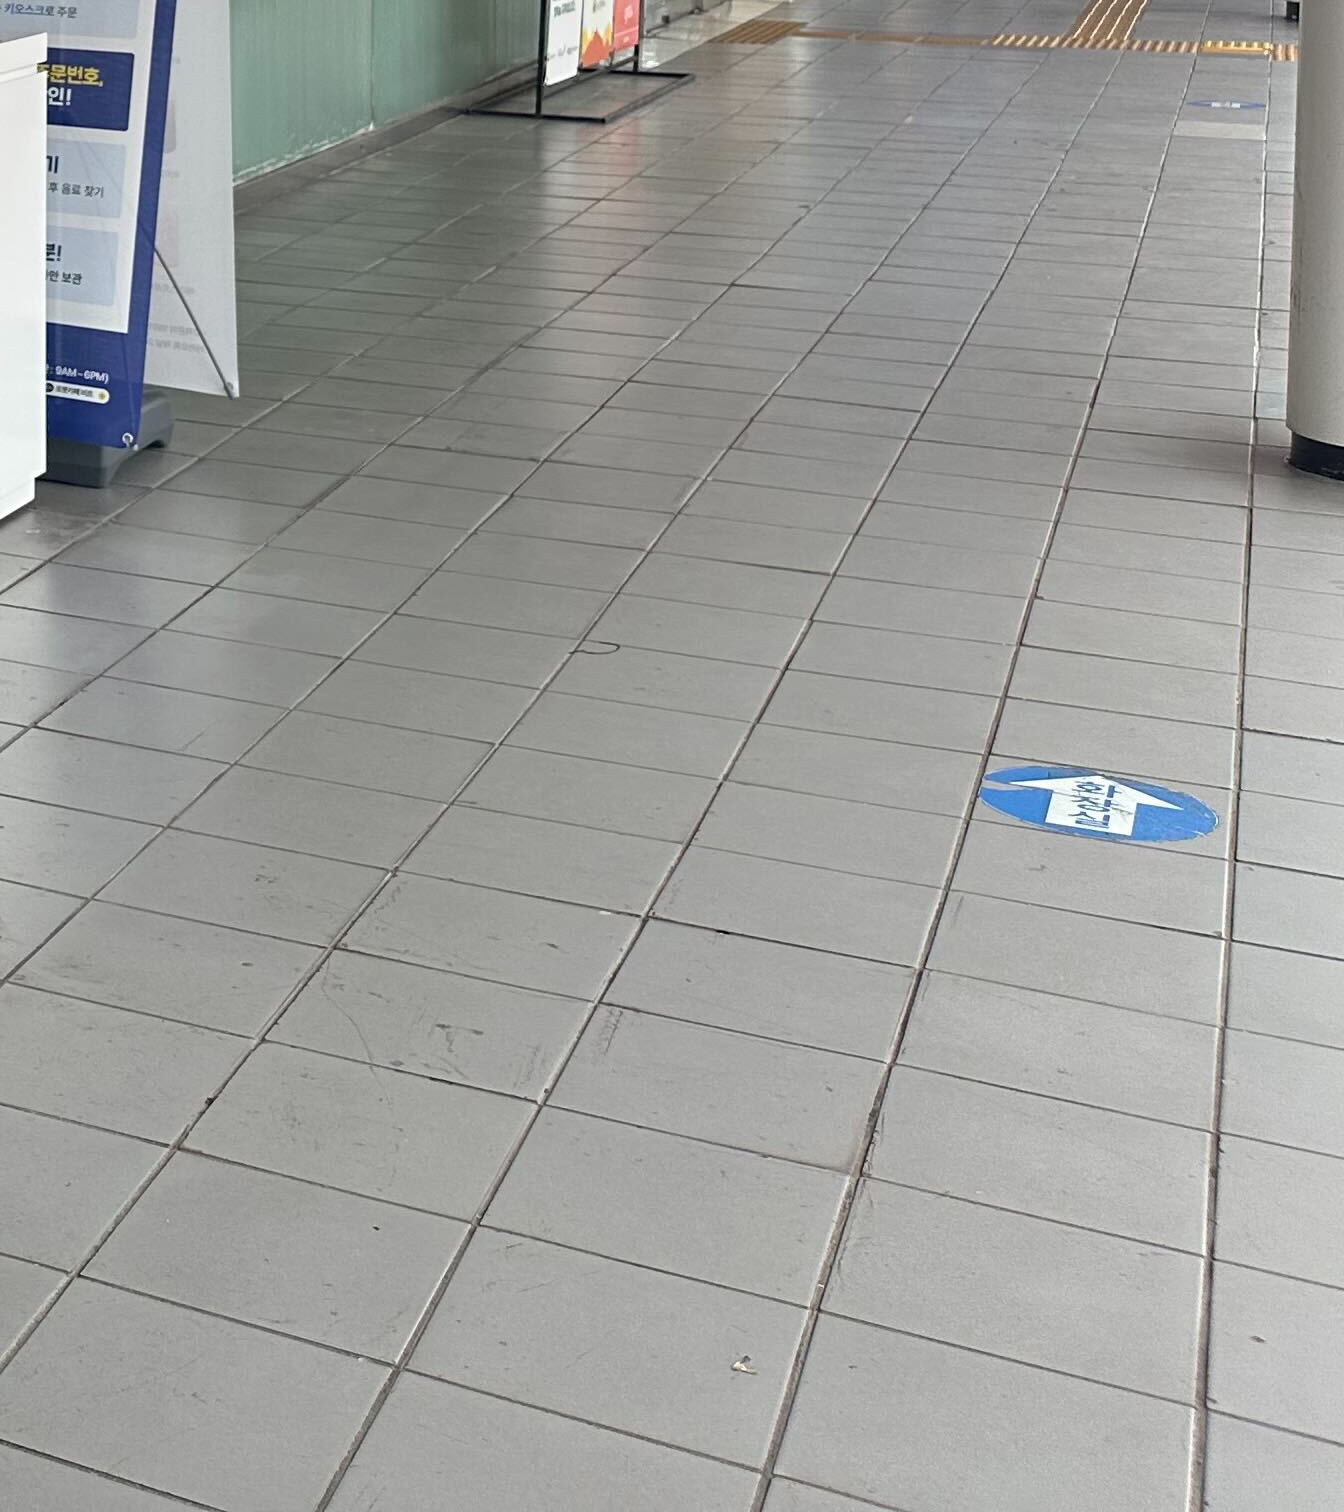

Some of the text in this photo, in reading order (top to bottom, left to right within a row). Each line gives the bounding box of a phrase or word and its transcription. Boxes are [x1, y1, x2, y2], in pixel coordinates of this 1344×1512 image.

[4, 2, 55, 17] 키오스크로
[57, 5, 78, 18] 주문
[47, 87, 72, 106] 인!
